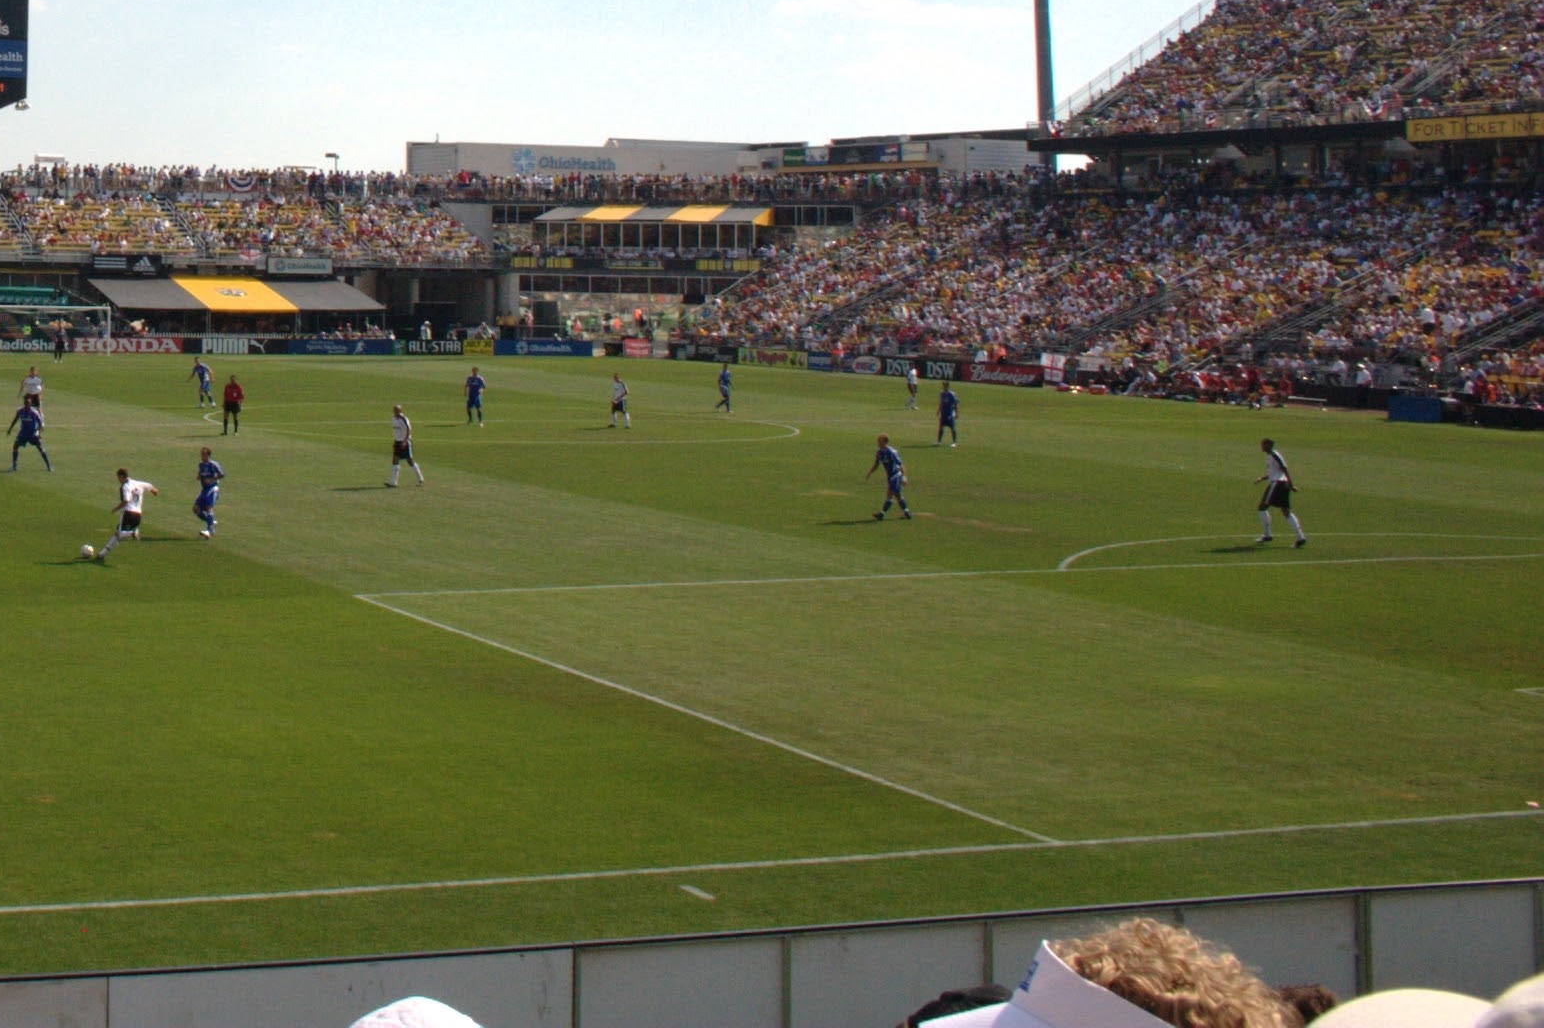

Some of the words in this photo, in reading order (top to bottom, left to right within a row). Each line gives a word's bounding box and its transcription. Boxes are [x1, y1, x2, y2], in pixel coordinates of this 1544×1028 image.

[1414, 123, 1444, 137] FOR
[1448, 120, 1506, 135] TICKET
[1512, 117, 1544, 133] INF
[538, 156, 616, 171] OhioHealth
[74, 338, 181, 353] HONDA
[202, 338, 249, 354] PUMA
[431, 341, 462, 353] STAR
[926, 361, 955, 380] DSW
[969, 364, 1036, 383] Budweiser
